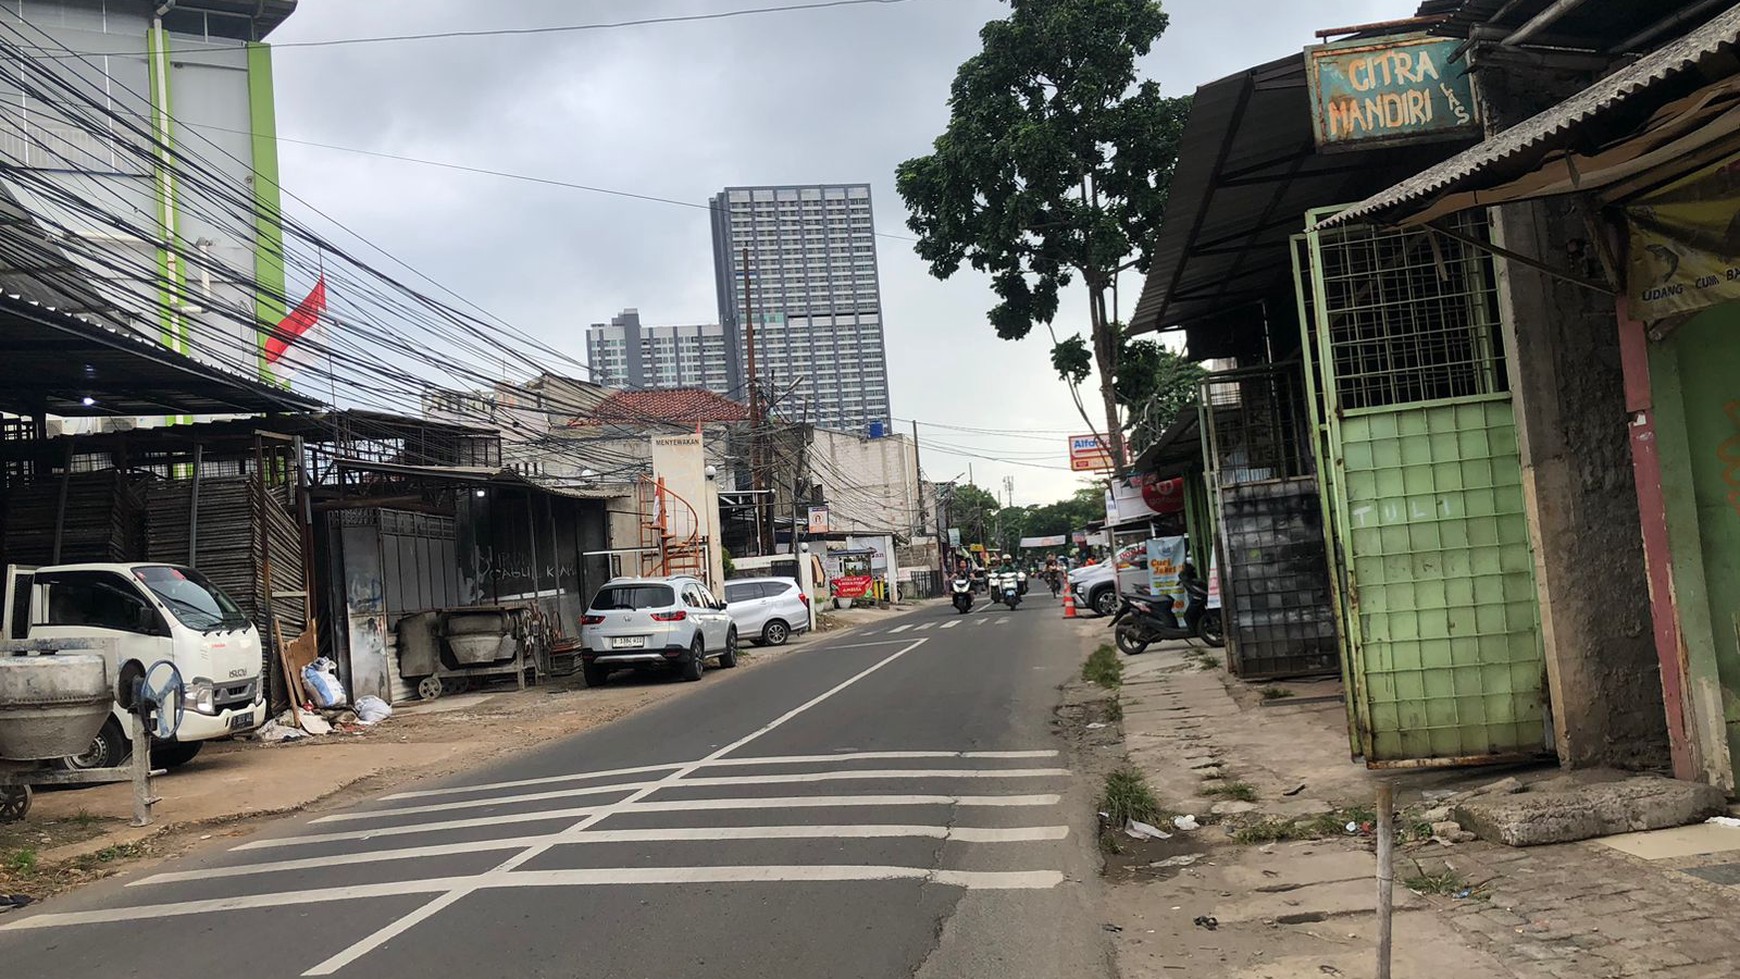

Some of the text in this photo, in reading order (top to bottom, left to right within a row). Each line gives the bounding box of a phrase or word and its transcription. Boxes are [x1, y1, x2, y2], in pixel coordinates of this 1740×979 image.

[1348, 50, 1439, 91] CITRA
[1328, 88, 1433, 135] MANDIRI
[1439, 82, 1469, 125] LAS
[1642, 283, 1684, 301] UDANG
[1353, 496, 1450, 526] TULI
